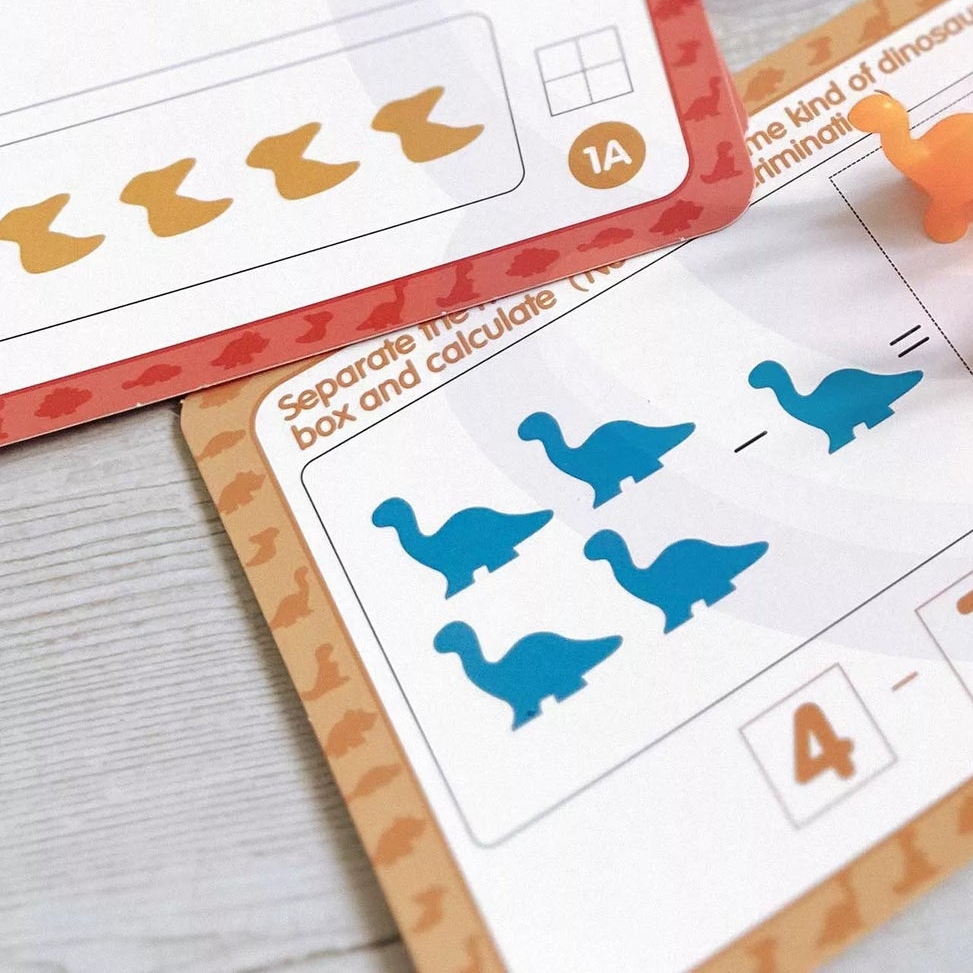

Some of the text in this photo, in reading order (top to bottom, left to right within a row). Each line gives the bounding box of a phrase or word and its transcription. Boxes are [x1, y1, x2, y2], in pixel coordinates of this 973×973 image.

[278, 334, 417, 421] Separate
[785, 83, 847, 128] kind
[848, 62, 878, 93] of
[582, 139, 633, 174] 1A
[290, 112, 853, 451] box and calculate riminati
[793, 701, 856, 785] 4
